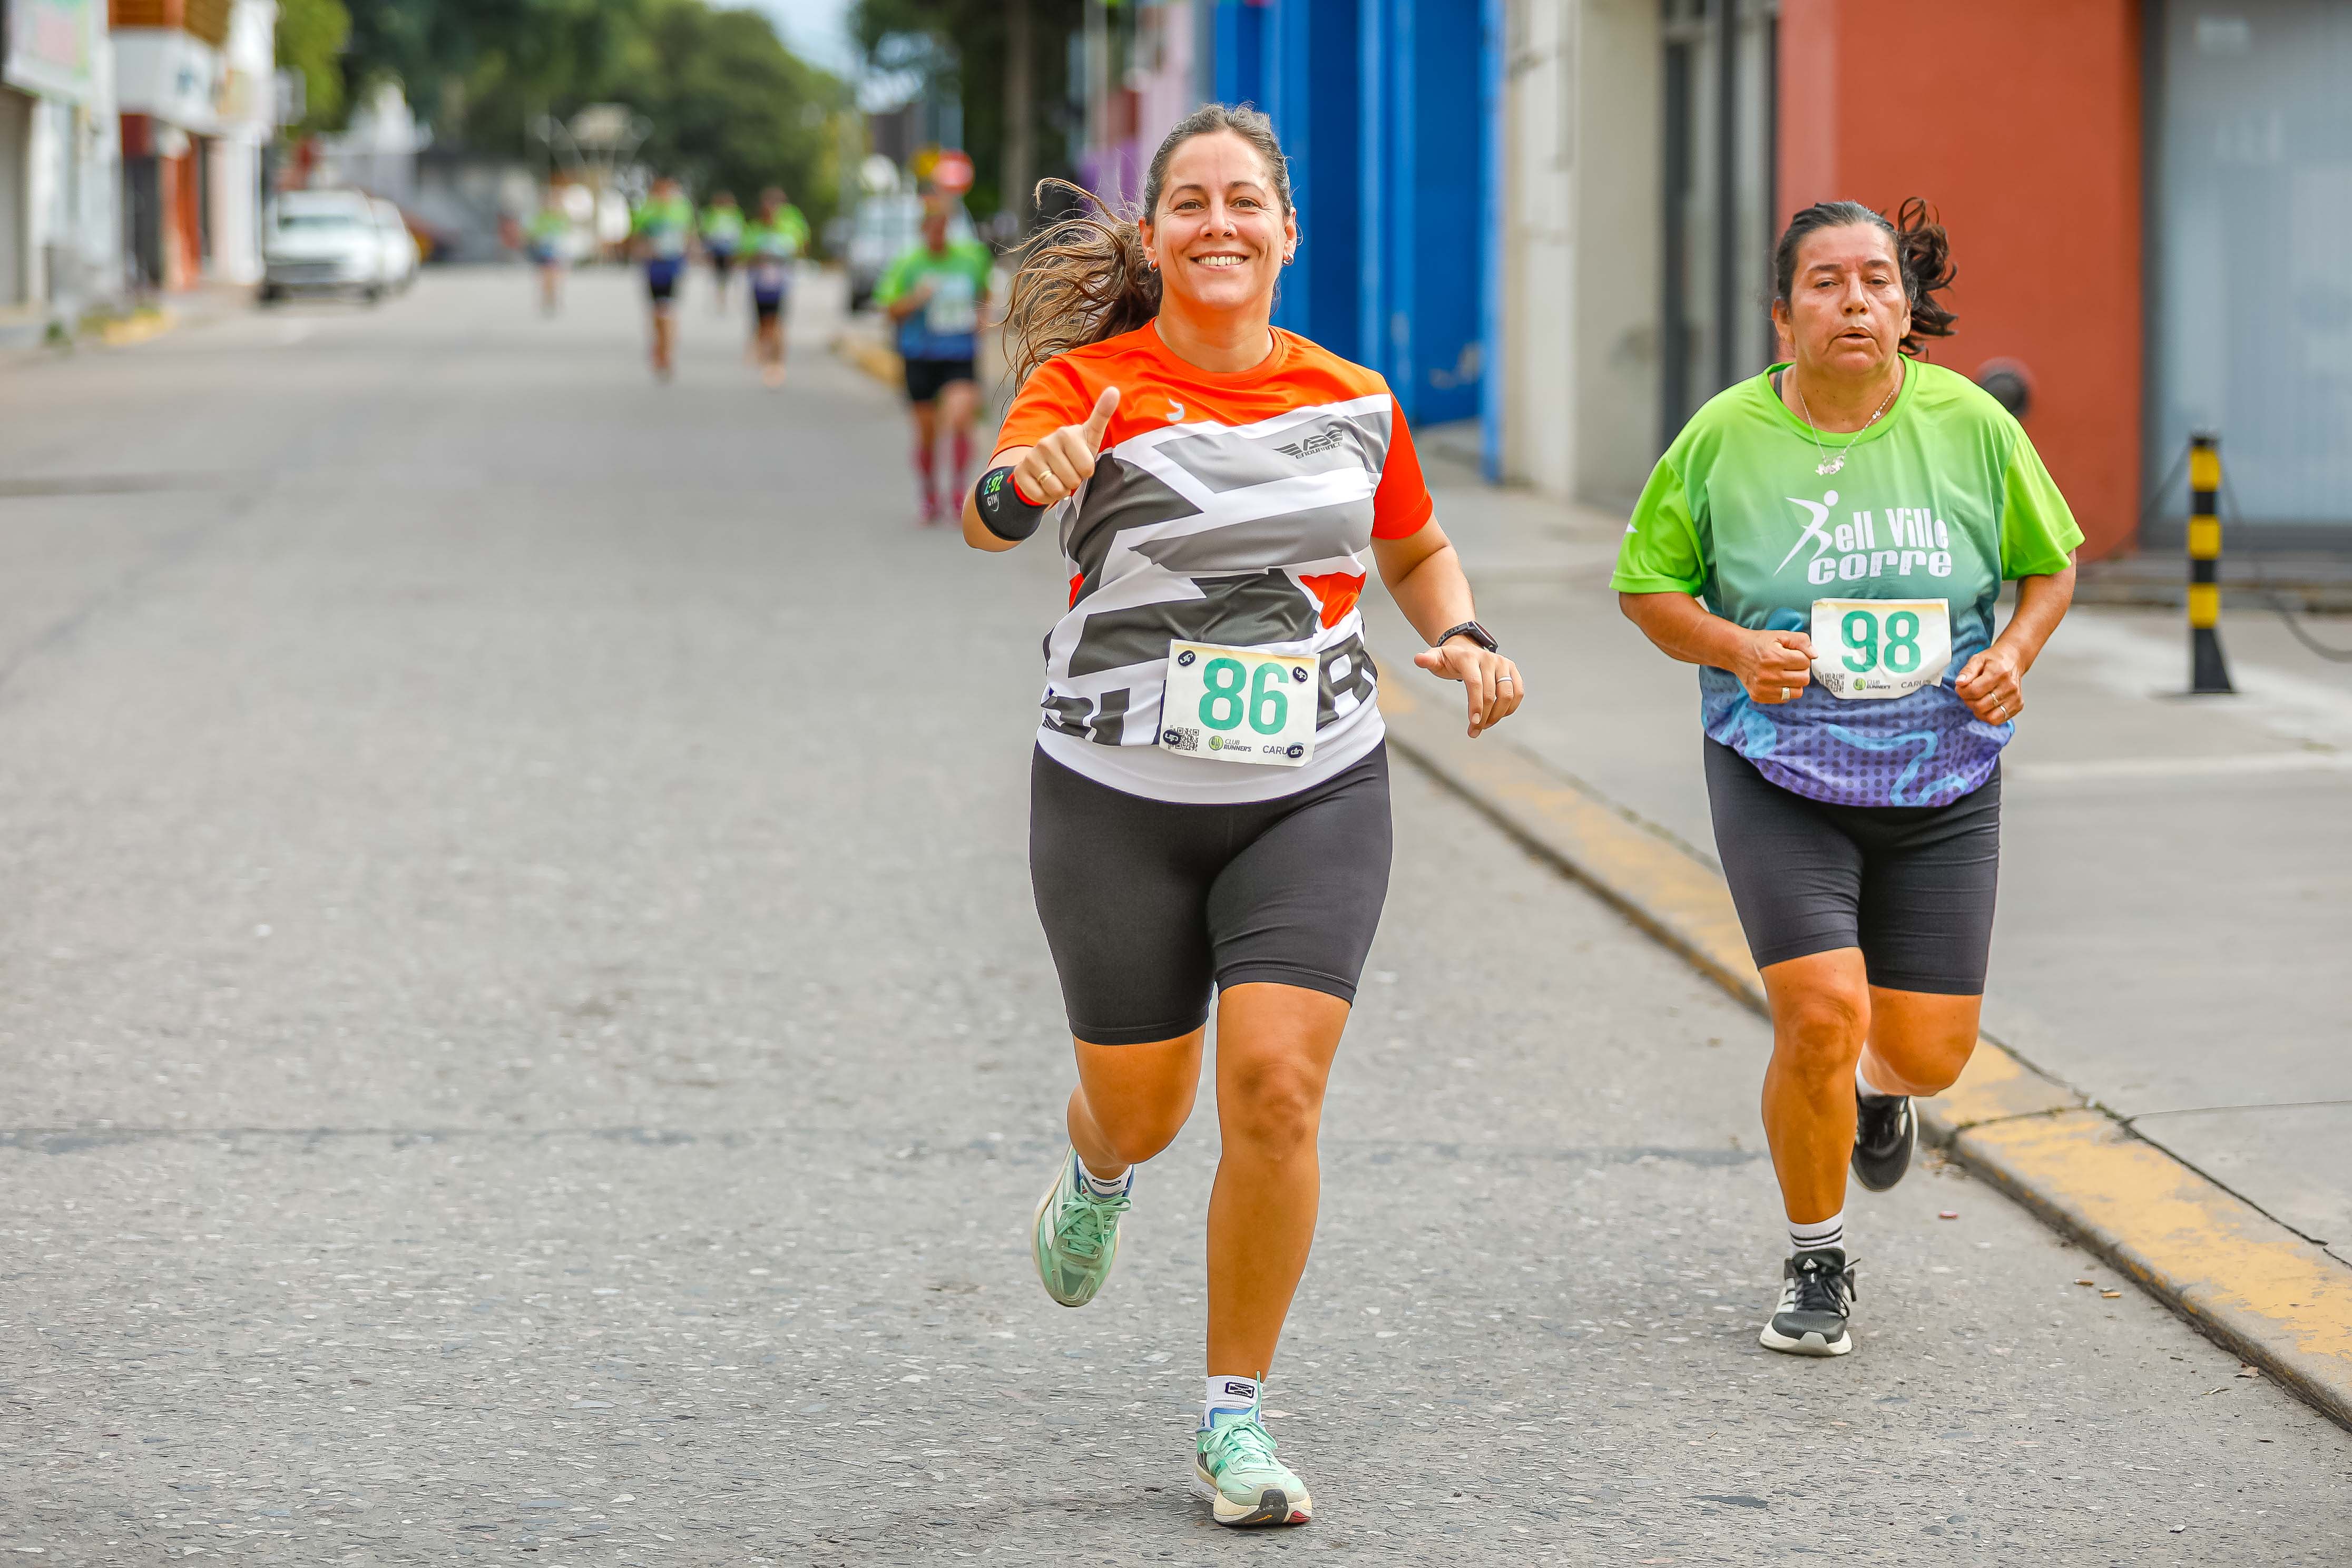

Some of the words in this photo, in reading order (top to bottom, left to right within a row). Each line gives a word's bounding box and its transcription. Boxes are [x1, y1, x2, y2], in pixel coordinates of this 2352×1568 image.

[987, 493, 998, 506] GYM
[1885, 507, 1948, 549] Ville
[1808, 550, 1952, 585] corre
[1841, 610, 1921, 673] 98
[1199, 658, 1289, 734] 86
[1223, 744, 1252, 752] RUNNER'S
[1262, 745, 1289, 755] CARU
